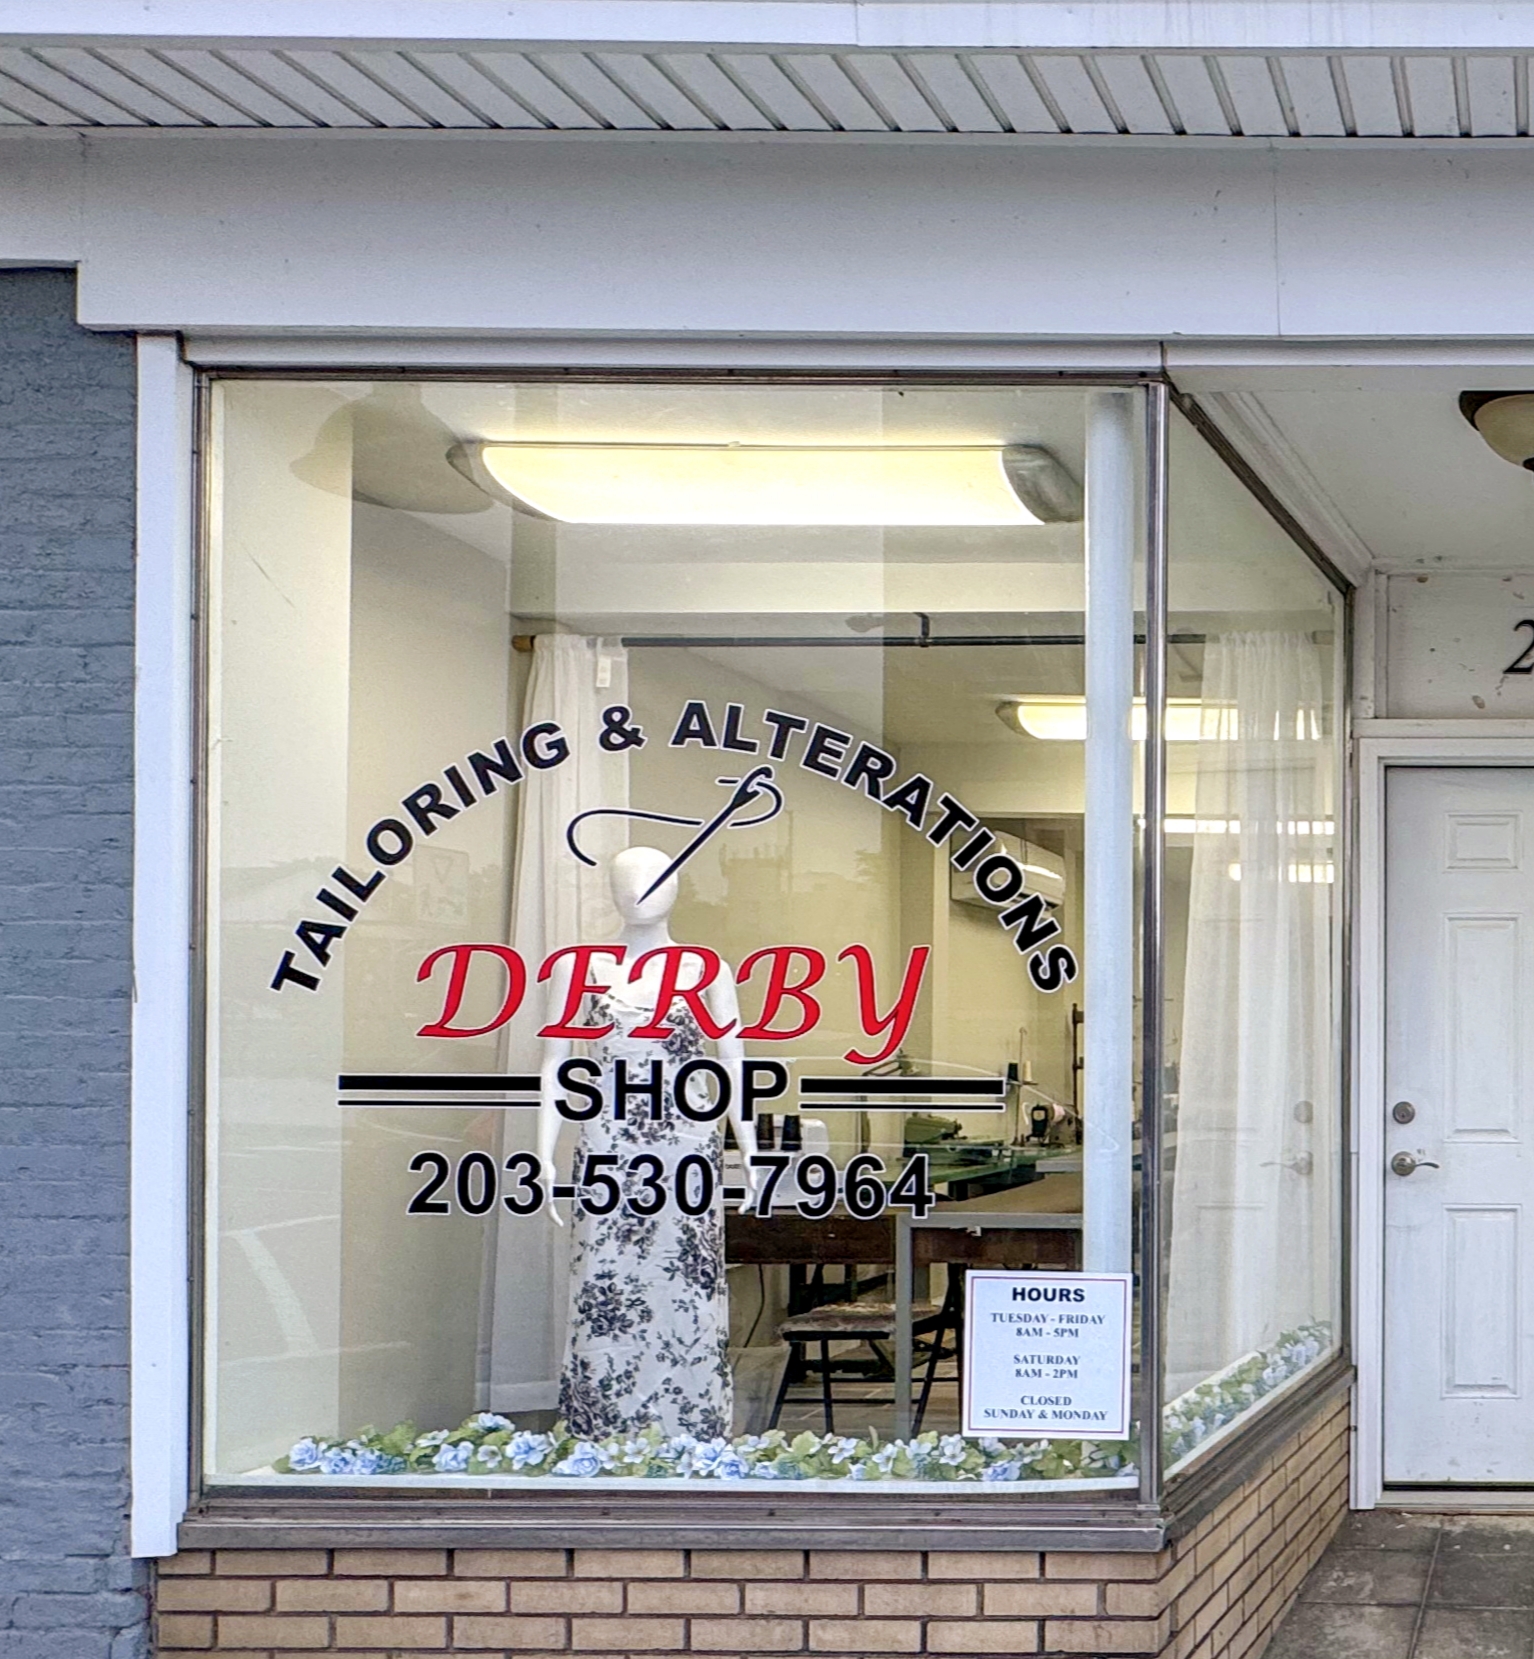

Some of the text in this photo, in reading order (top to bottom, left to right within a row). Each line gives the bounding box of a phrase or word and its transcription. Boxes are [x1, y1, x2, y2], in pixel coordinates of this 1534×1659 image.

[269, 700, 1080, 995] TAILORING & ALTERATIONS
[415, 942, 931, 1065] DERBY
[553, 1057, 791, 1122] SHOP
[406, 1150, 935, 1219] 203-530-7964
[1012, 1287, 1085, 1302] HOURS
[990, 1312, 1049, 1324] TUESDAY
[1058, 1314, 1106, 1325] FRIDAY
[1015, 1327, 1043, 1337] 8AM
[1053, 1328, 1079, 1338] 5PM
[1013, 1354, 1081, 1365] SATURDAY
[1015, 1368, 1042, 1378] 8AM
[1052, 1369, 1078, 1379] 2PM
[1020, 1395, 1072, 1406] CLOSED
[984, 1408, 1108, 1421] SUNDAY & MONDAY
